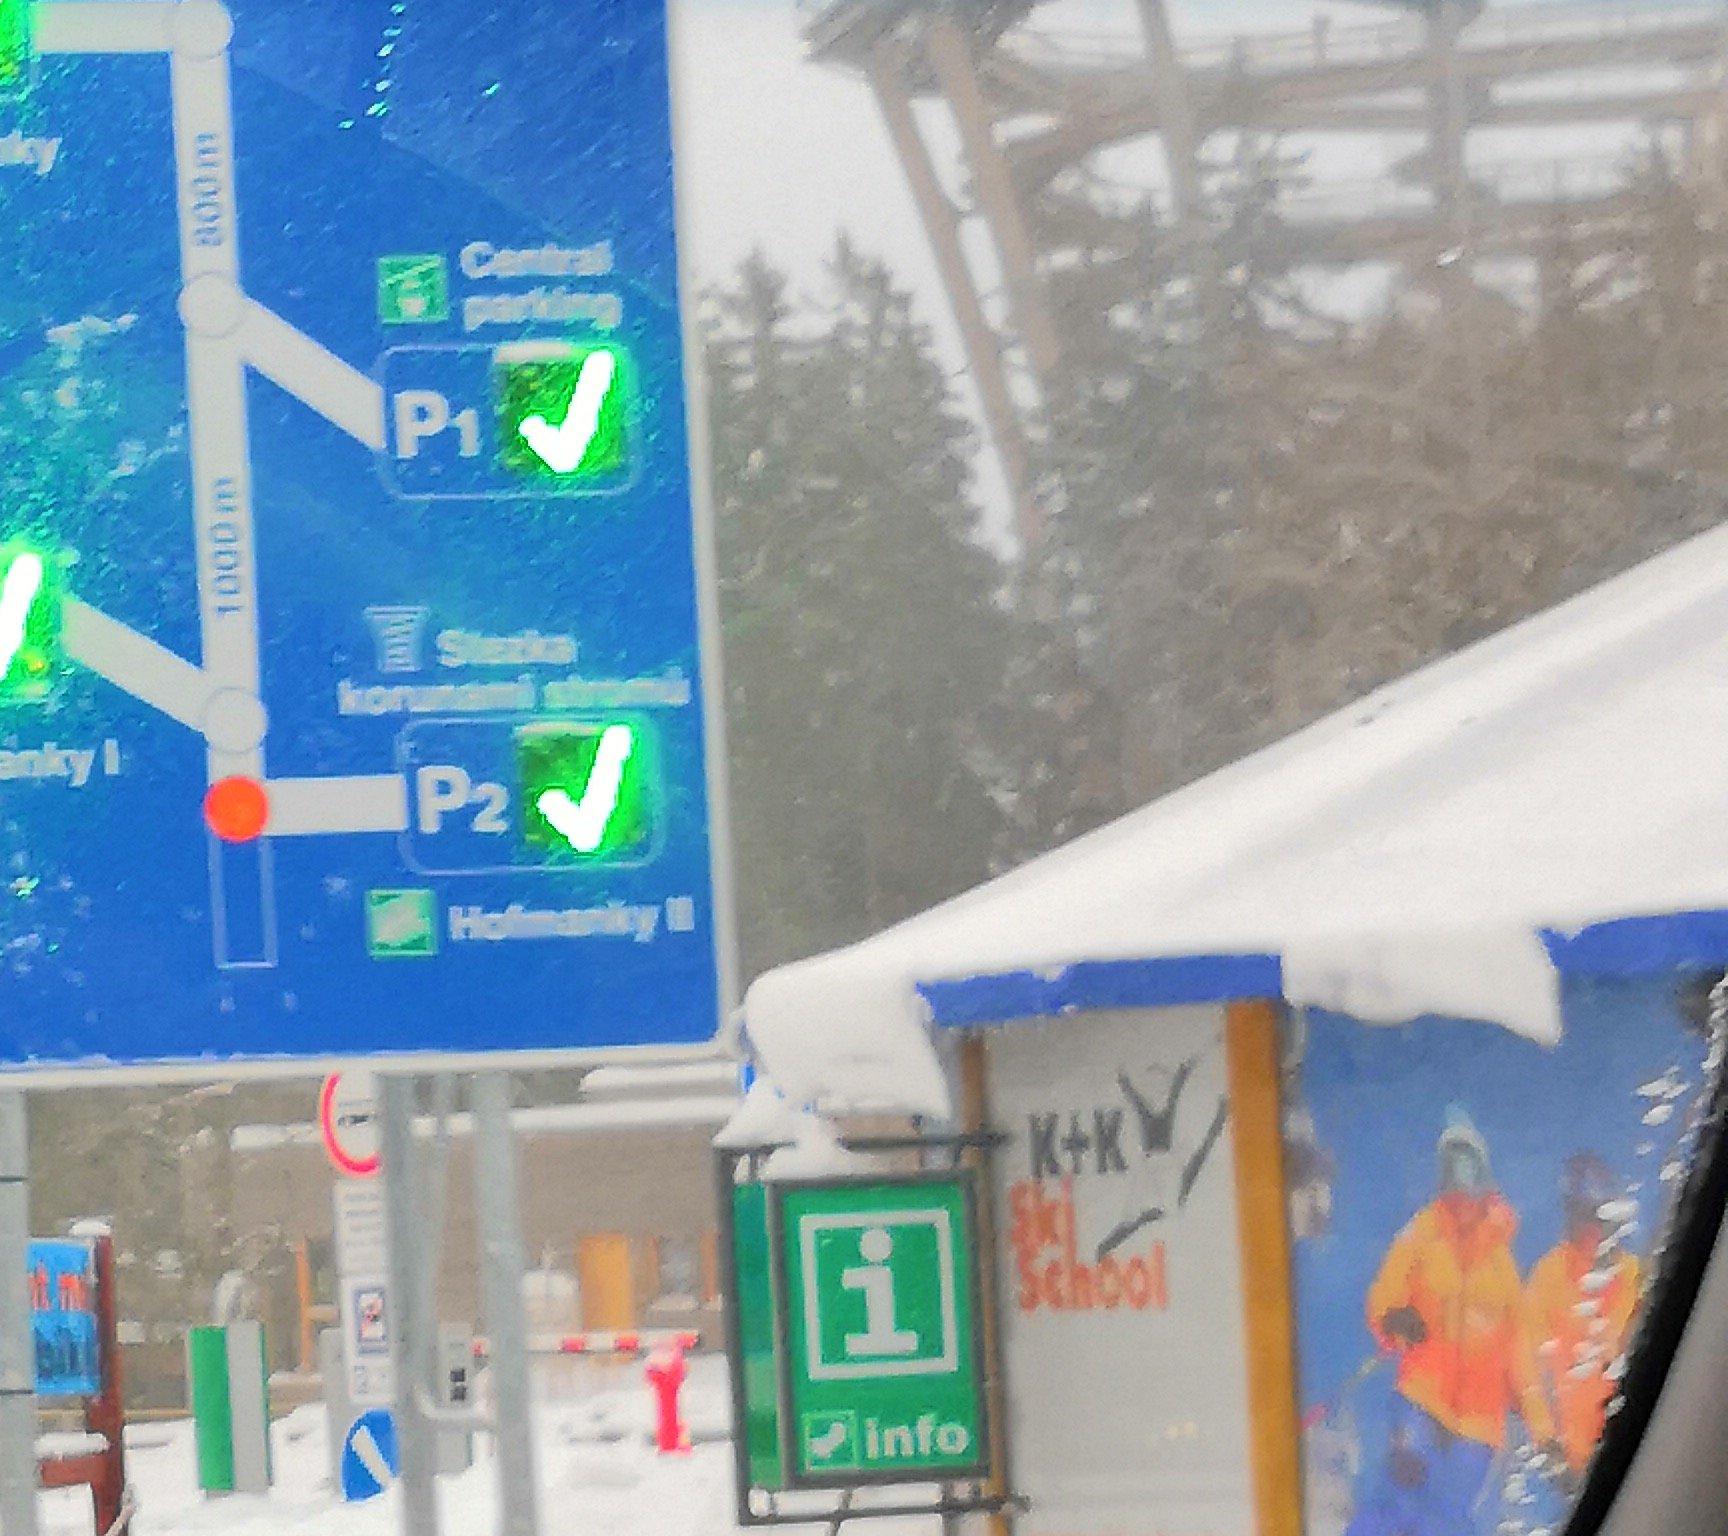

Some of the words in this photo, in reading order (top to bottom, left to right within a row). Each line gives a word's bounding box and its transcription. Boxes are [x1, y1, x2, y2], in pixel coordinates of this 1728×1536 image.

[192, 174, 221, 246] 800
[394, 389, 484, 459] P1
[209, 521, 244, 614] 1000
[416, 764, 511, 835] P2
[1016, 1240, 1169, 1314] School
[862, 1412, 970, 1461] info
